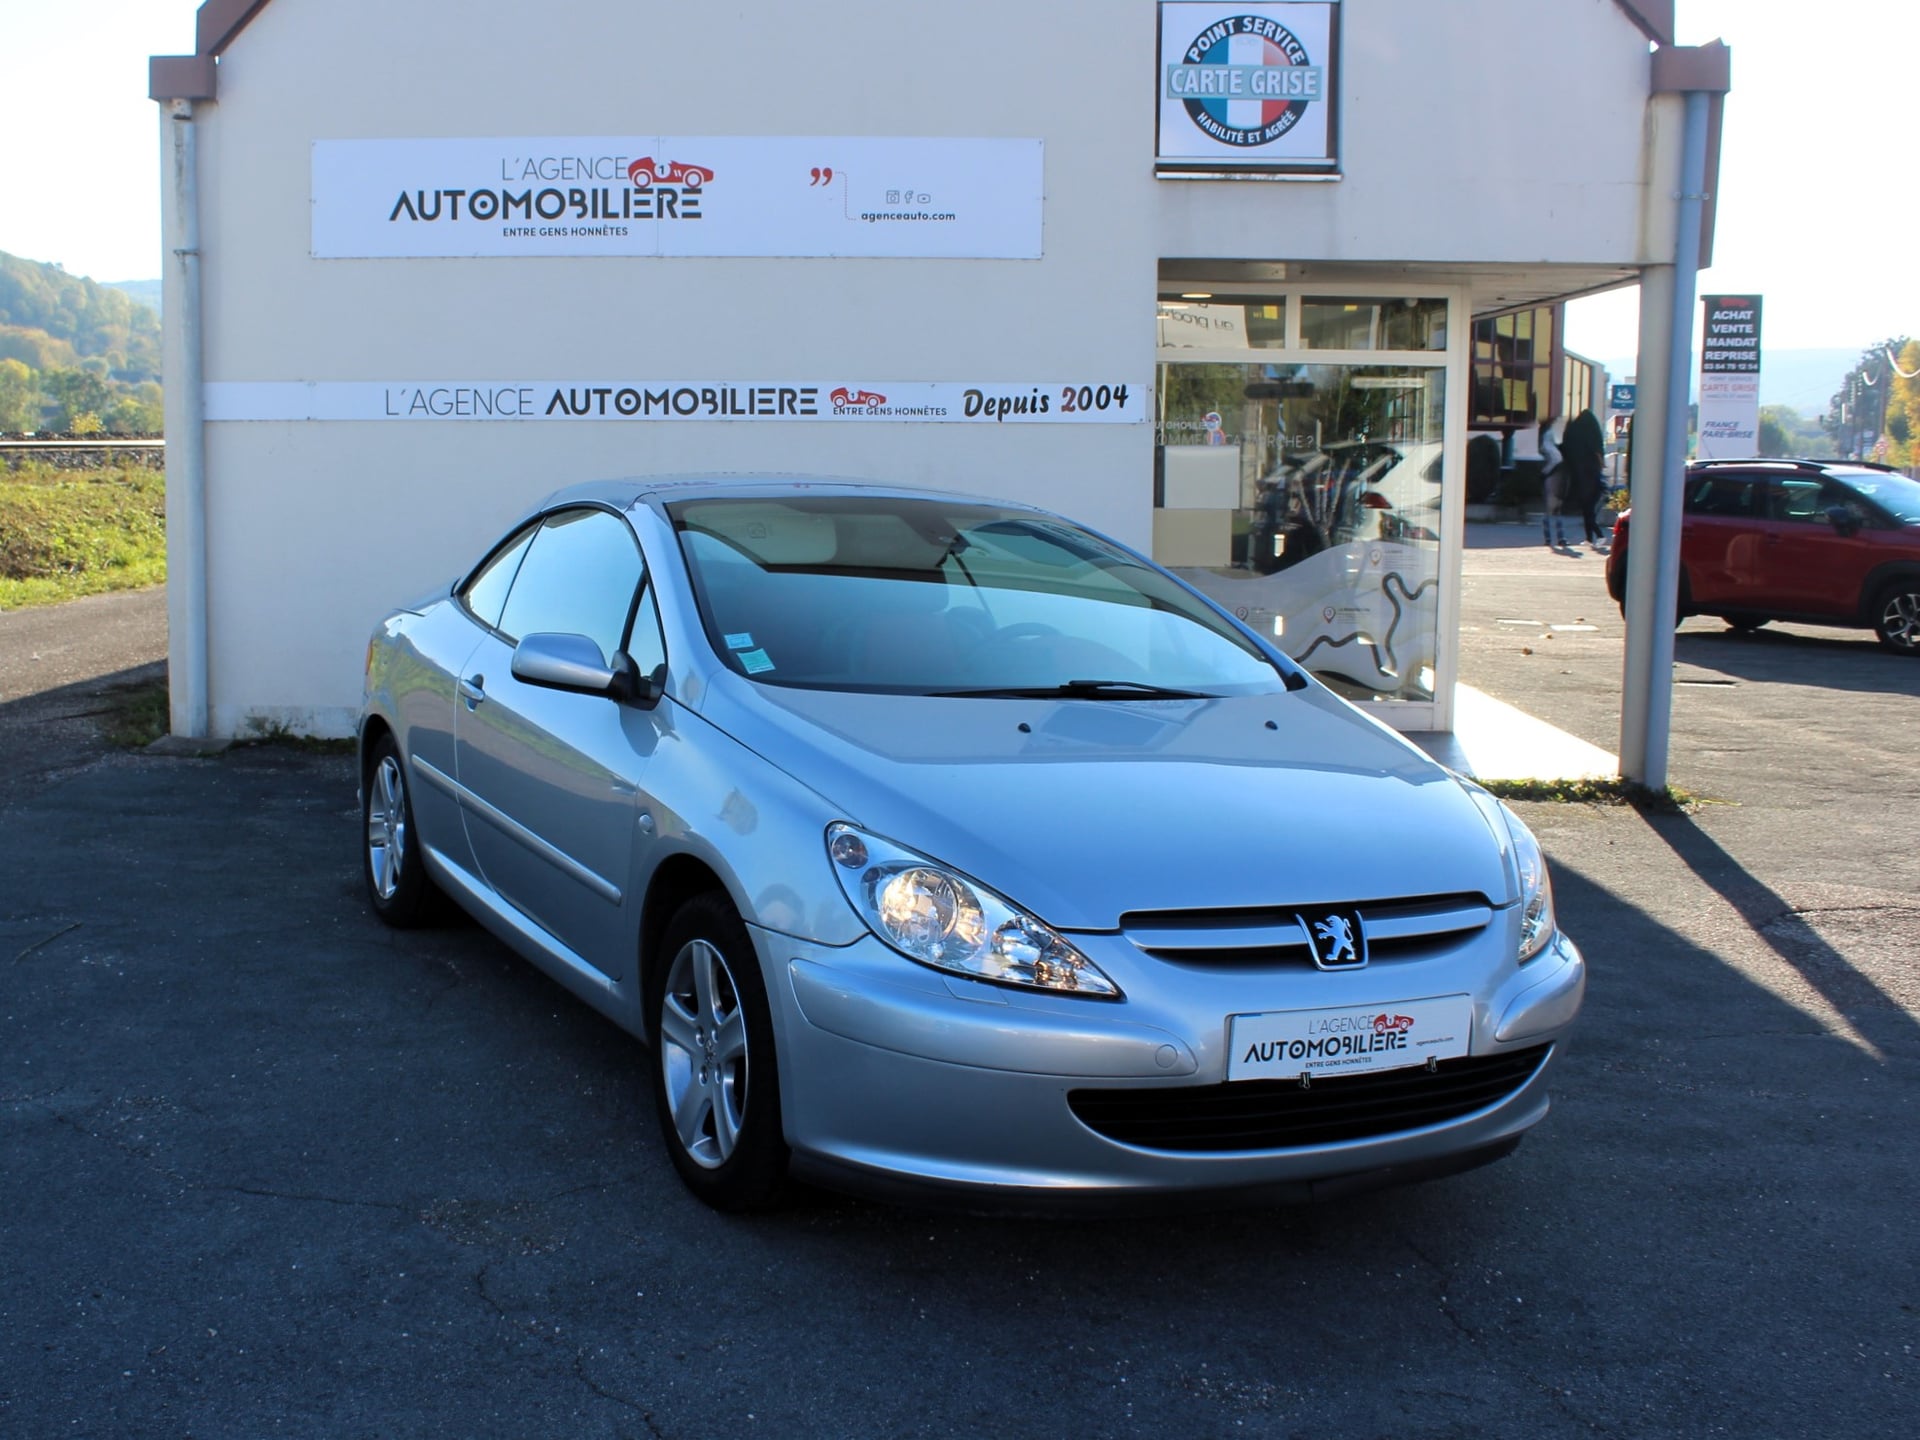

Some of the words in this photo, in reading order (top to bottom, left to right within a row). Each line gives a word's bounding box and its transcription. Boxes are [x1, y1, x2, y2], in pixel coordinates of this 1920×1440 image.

[1188, 18, 1236, 63] POINT
[1242, 16, 1305, 66] SERVICE
[1170, 68, 1243, 94] CARTE
[1251, 69, 1318, 96] GRISE
[1196, 111, 1244, 144] HABILITÉ
[1247, 130, 1262, 144] ET
[1264, 110, 1297, 140] AGRÉÉ
[501, 156, 629, 182] L'AGENCE
[860, 211, 957, 223] agenceauto.com
[502, 227, 537, 238] ENTRE
[539, 227, 569, 237] GENS
[570, 223, 629, 237] HONNÊTES
[1712, 310, 1754, 320] ACHAT
[1712, 324, 1754, 334] VENTE
[1706, 337, 1758, 347] MANDAT
[1705, 351, 1757, 361] REPRISE
[1702, 383, 1729, 392] CARTE
[385, 388, 535, 416] L'AGENCE
[963, 387, 1050, 423] Depuis
[1061, 383, 1129, 413] 2004
[832, 406, 864, 416] ENTRE
[866, 406, 893, 416] GENS
[895, 404, 948, 416] HONNÊTES
[1705, 420, 1740, 429] FRANCE
[1702, 430, 1754, 439] PARE-BRISE
[1308, 1014, 1376, 1035] L'AGENCE
[1305, 1060, 1324, 1069] ENTRE
[1325, 1058, 1341, 1067] GENS
